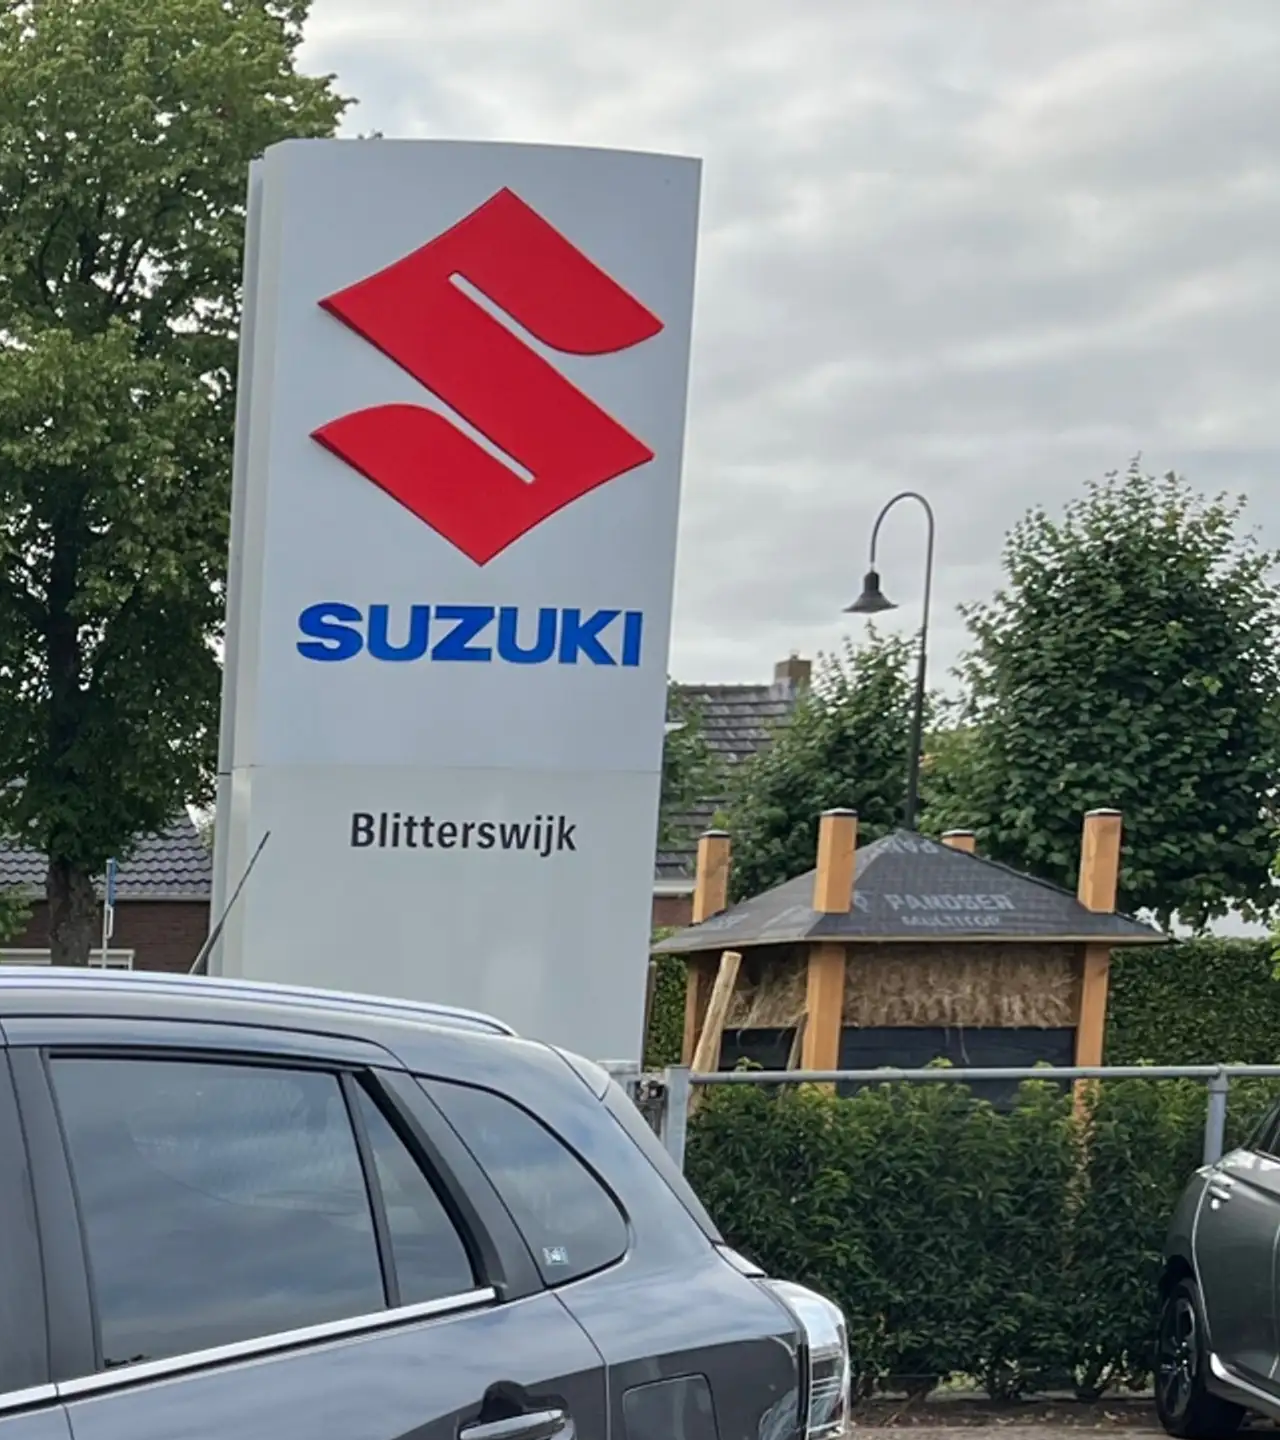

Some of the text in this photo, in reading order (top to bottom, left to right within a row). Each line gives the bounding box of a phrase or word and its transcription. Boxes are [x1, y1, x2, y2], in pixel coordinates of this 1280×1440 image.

[296, 601, 643, 667] SUZUKI
[350, 812, 577, 858] Blitterswijk
[884, 894, 1016, 911] PANDSER
